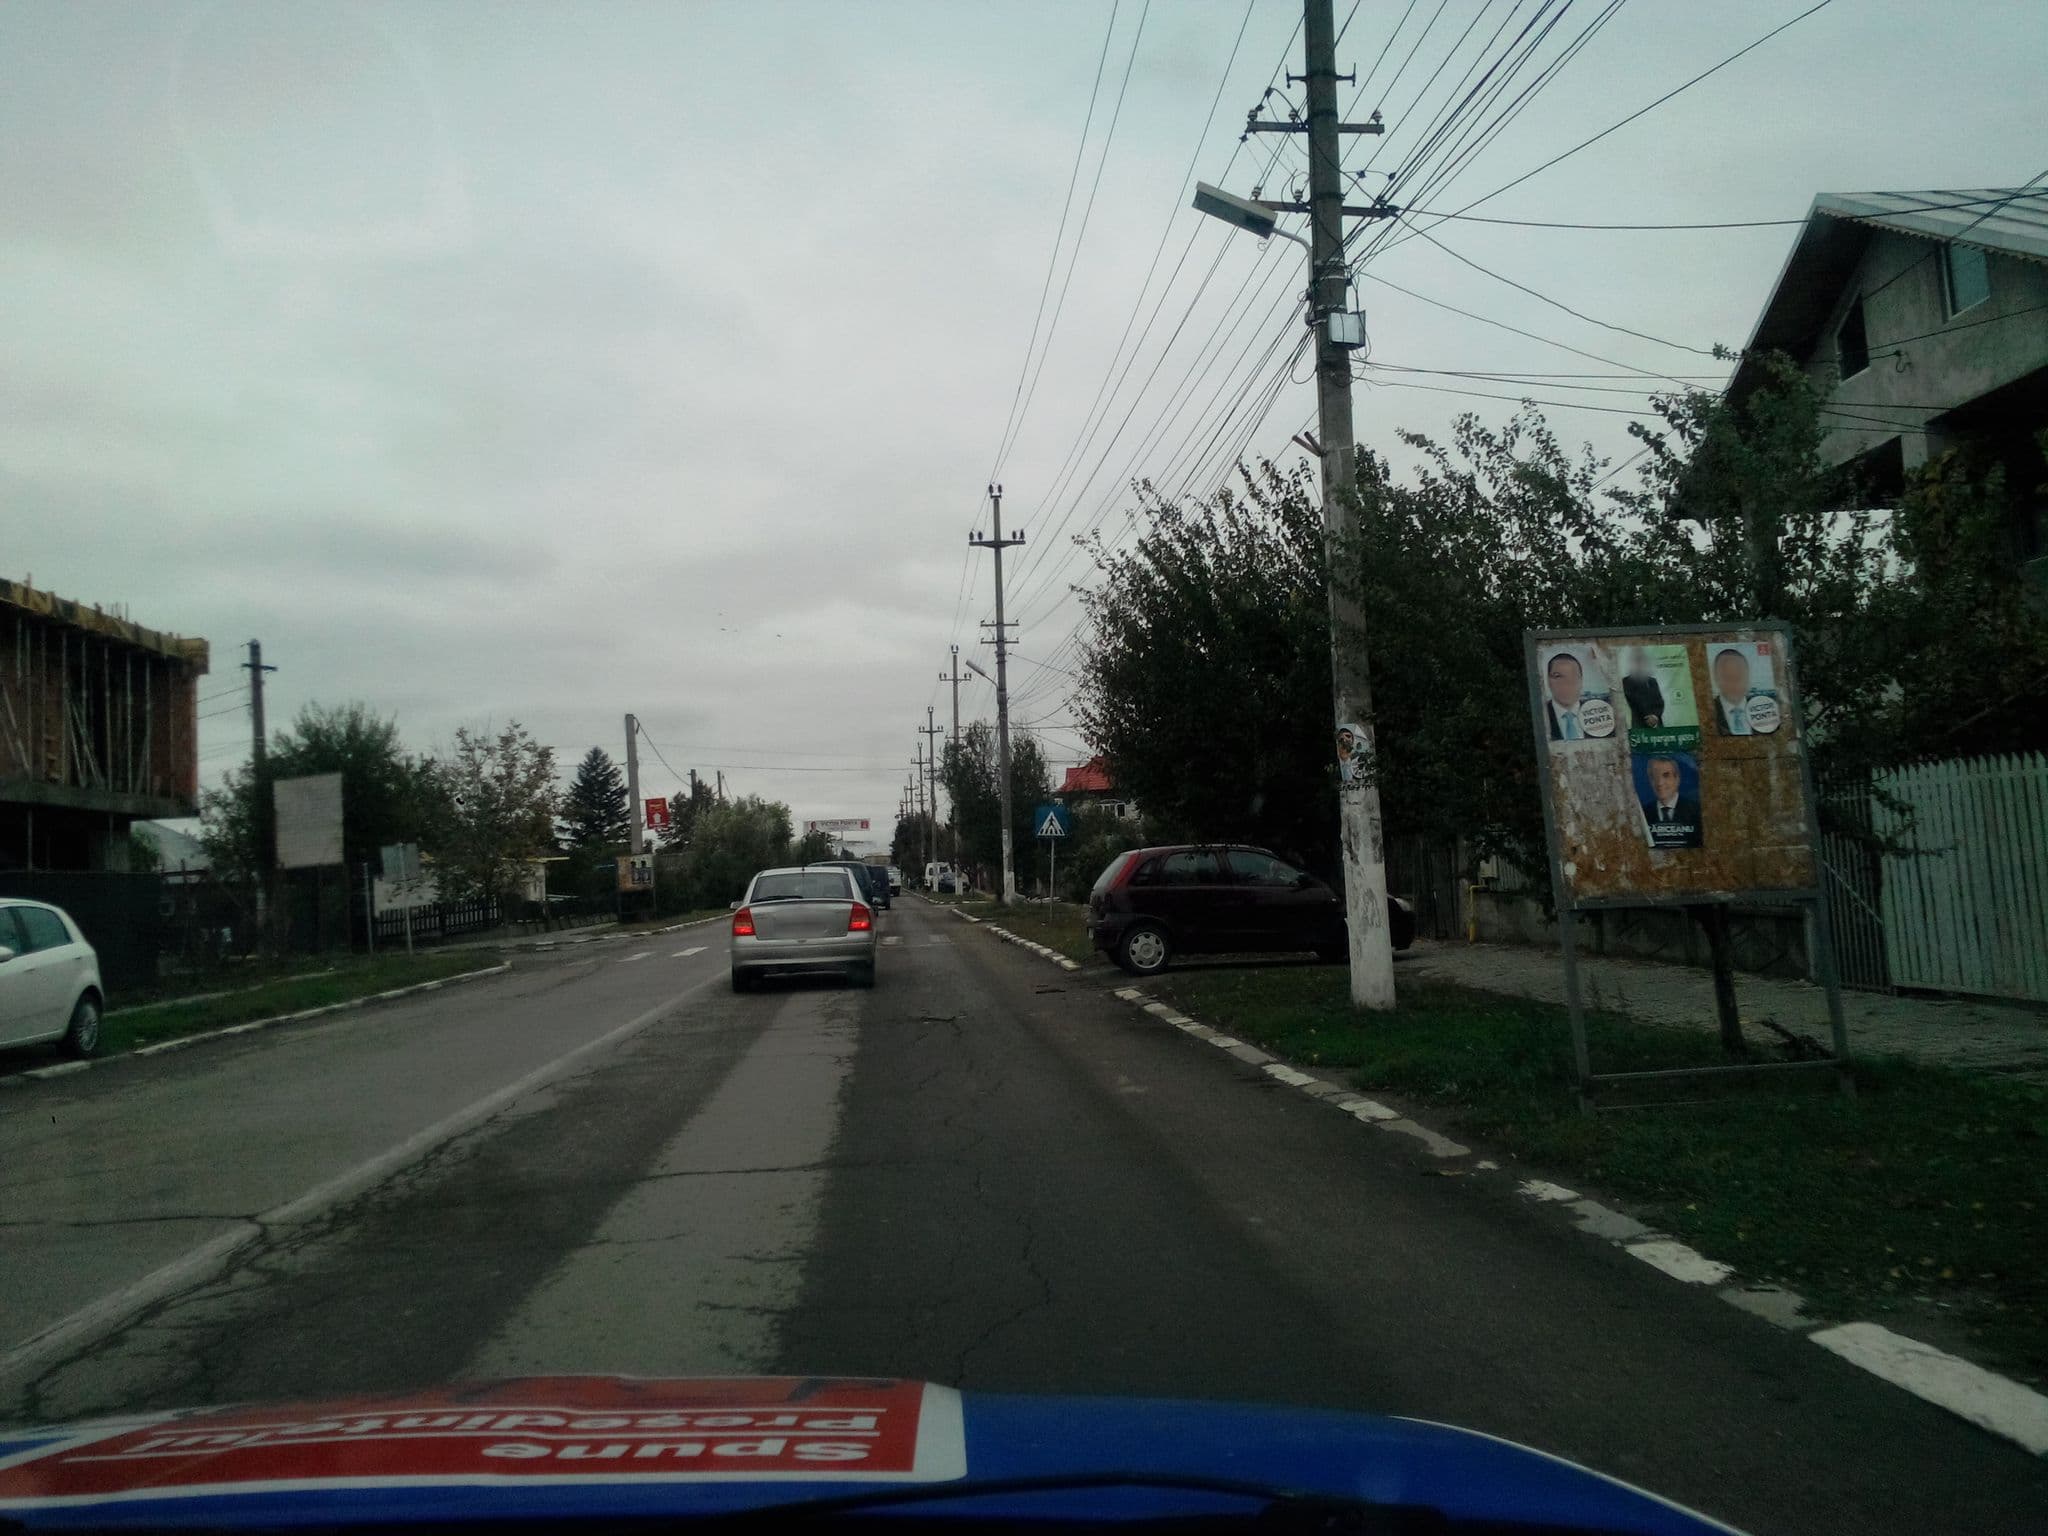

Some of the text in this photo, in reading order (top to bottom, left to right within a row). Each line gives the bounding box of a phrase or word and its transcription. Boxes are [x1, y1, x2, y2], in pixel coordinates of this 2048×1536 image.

[1582, 706, 1609, 717] VICTOR
[1750, 702, 1774, 713] VICTOR
[1583, 714, 1613, 726] PONTA
[1750, 711, 1777, 721] PONTA
[480, 1439, 872, 1461] Spune
